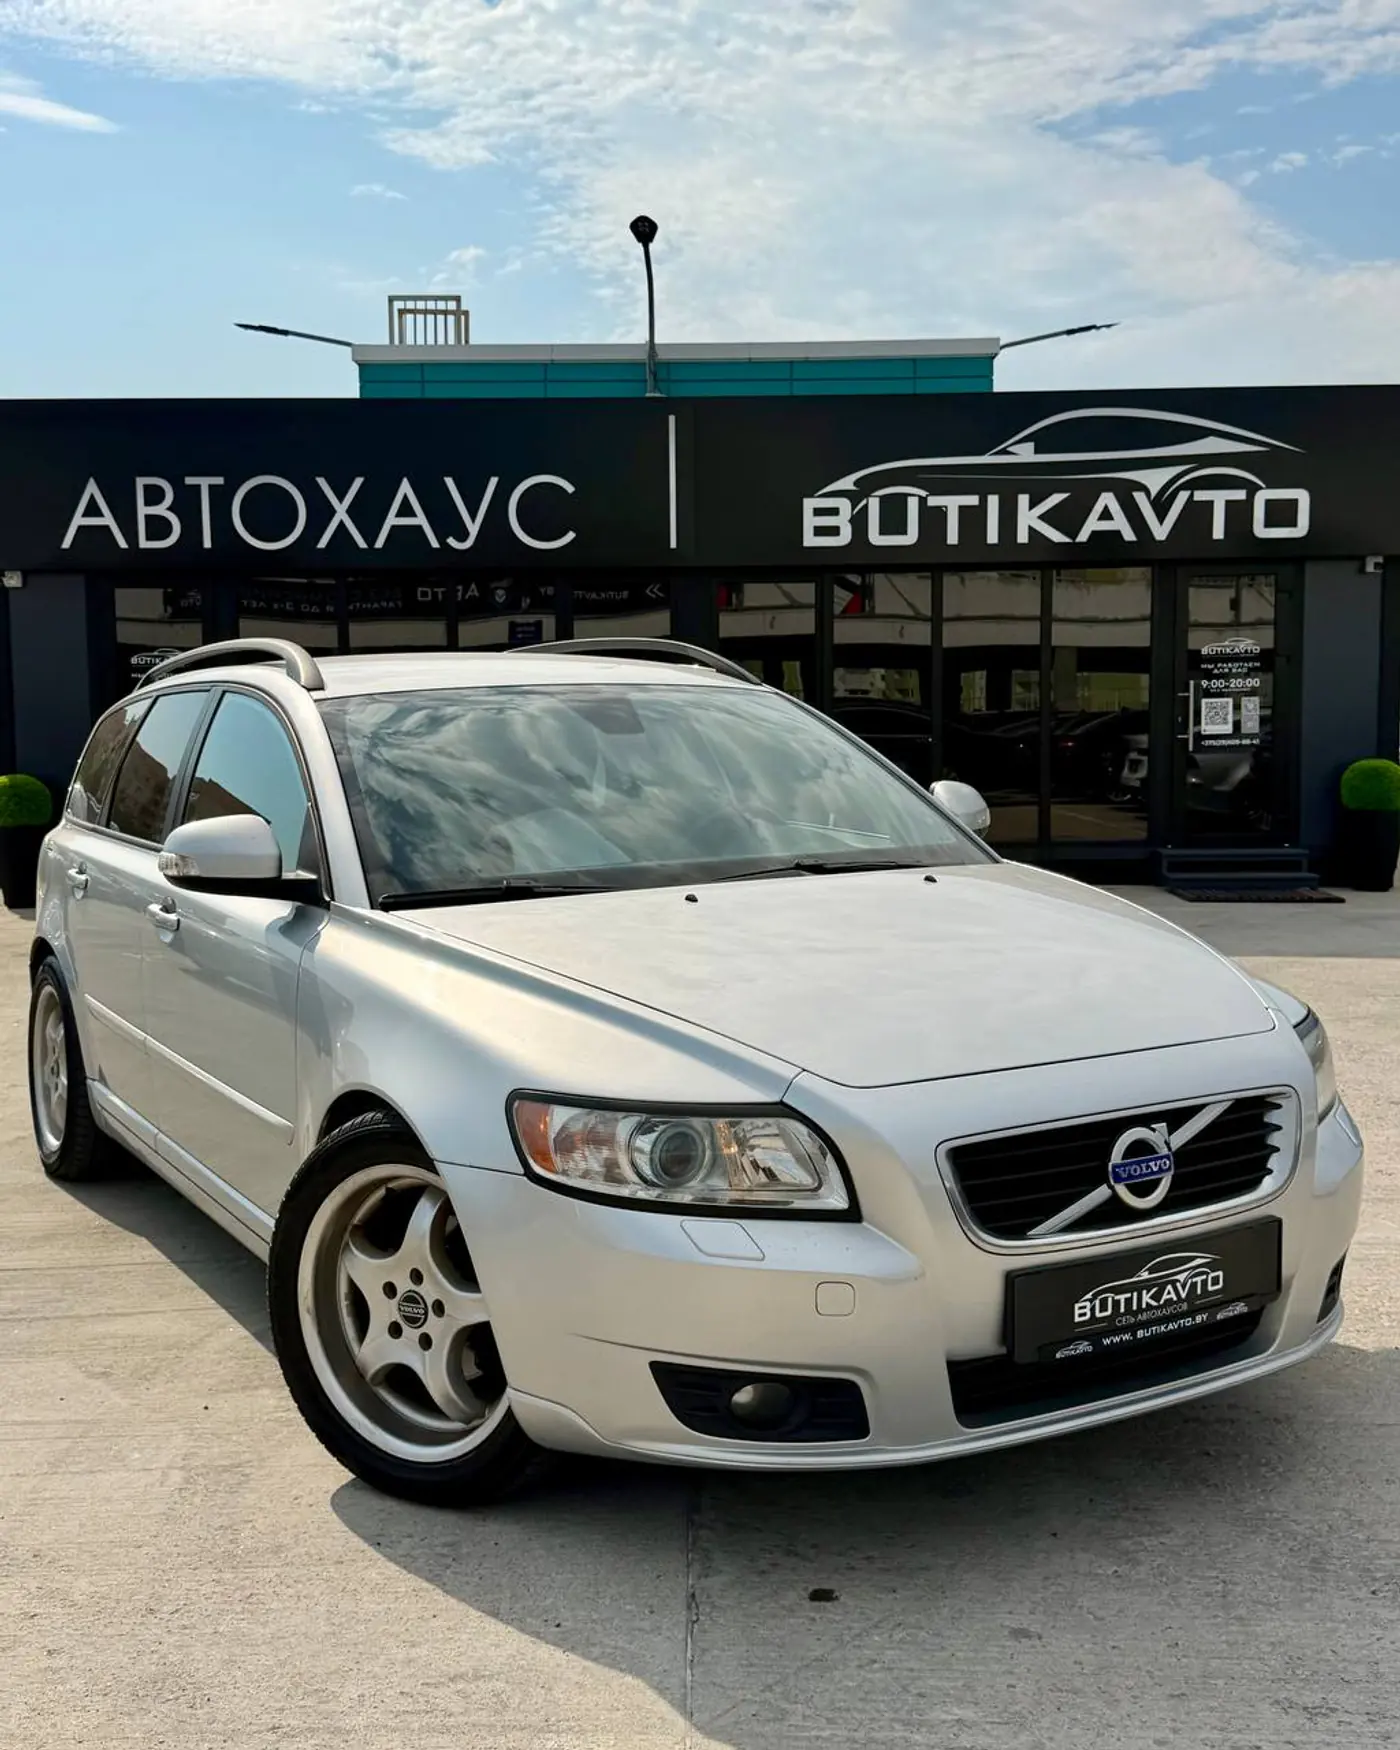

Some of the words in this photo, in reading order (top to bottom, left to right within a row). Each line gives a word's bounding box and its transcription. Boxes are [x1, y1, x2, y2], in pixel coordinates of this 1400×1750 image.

[61, 473, 577, 550] АВТОХАУС
[802, 487, 1310, 548] BUTIKAVTO
[1201, 645, 1260, 655] BUTIKAVTO
[1201, 678, 1261, 689] 9:00-20:00
[1115, 1159, 1170, 1179] VOLVO
[1074, 1271, 1223, 1323] BUTIKAVTO
[399, 1305, 425, 1315] VOLVO
[1116, 1315, 1135, 1326] СЕТЬ
[1137, 1313, 1208, 1338] BUTIKAVTO.BY
